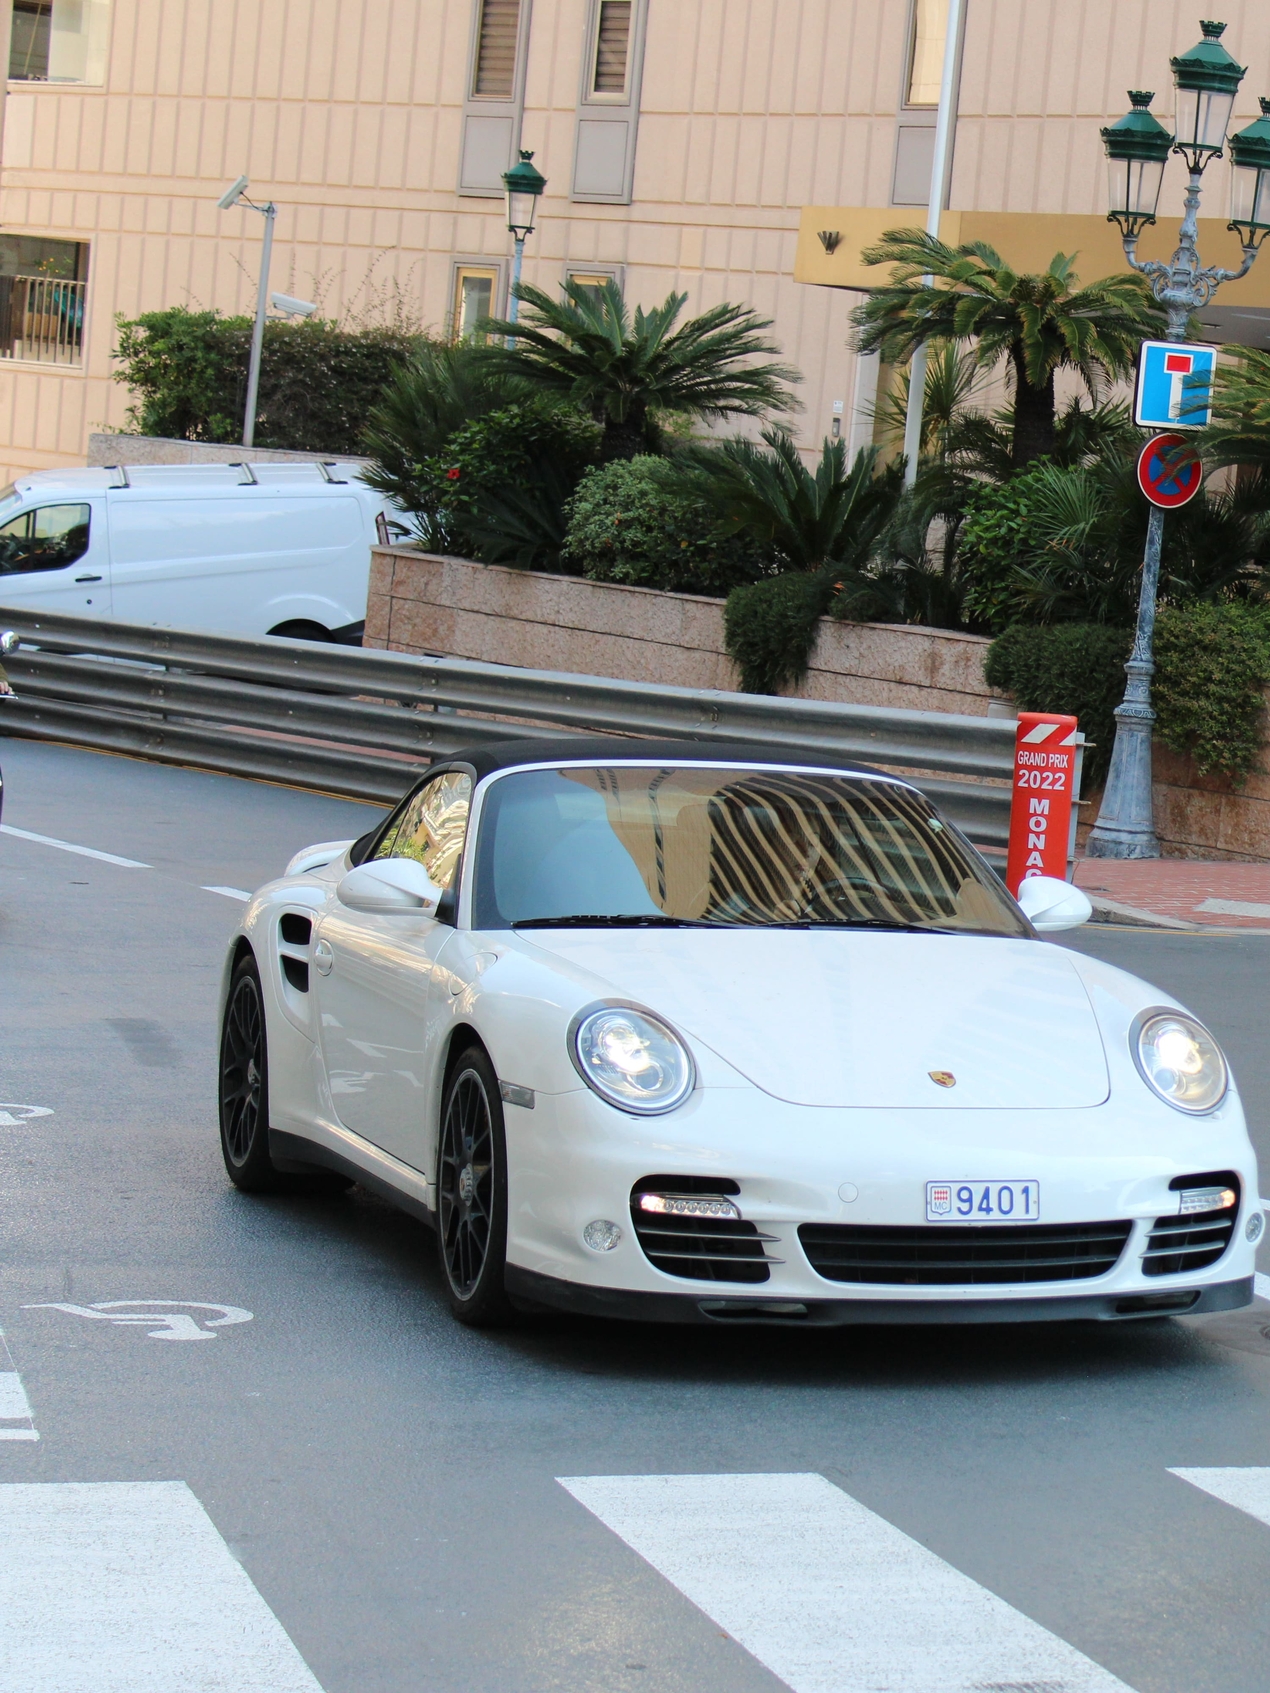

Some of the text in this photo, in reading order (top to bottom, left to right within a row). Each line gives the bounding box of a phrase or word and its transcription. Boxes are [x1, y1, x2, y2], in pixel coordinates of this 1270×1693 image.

[1017, 751, 1069, 768] GRAND PRIX
[1017, 769, 1066, 790] 2022
[934, 1202, 948, 1210] MC
[956, 1185, 1030, 1215] 9401
